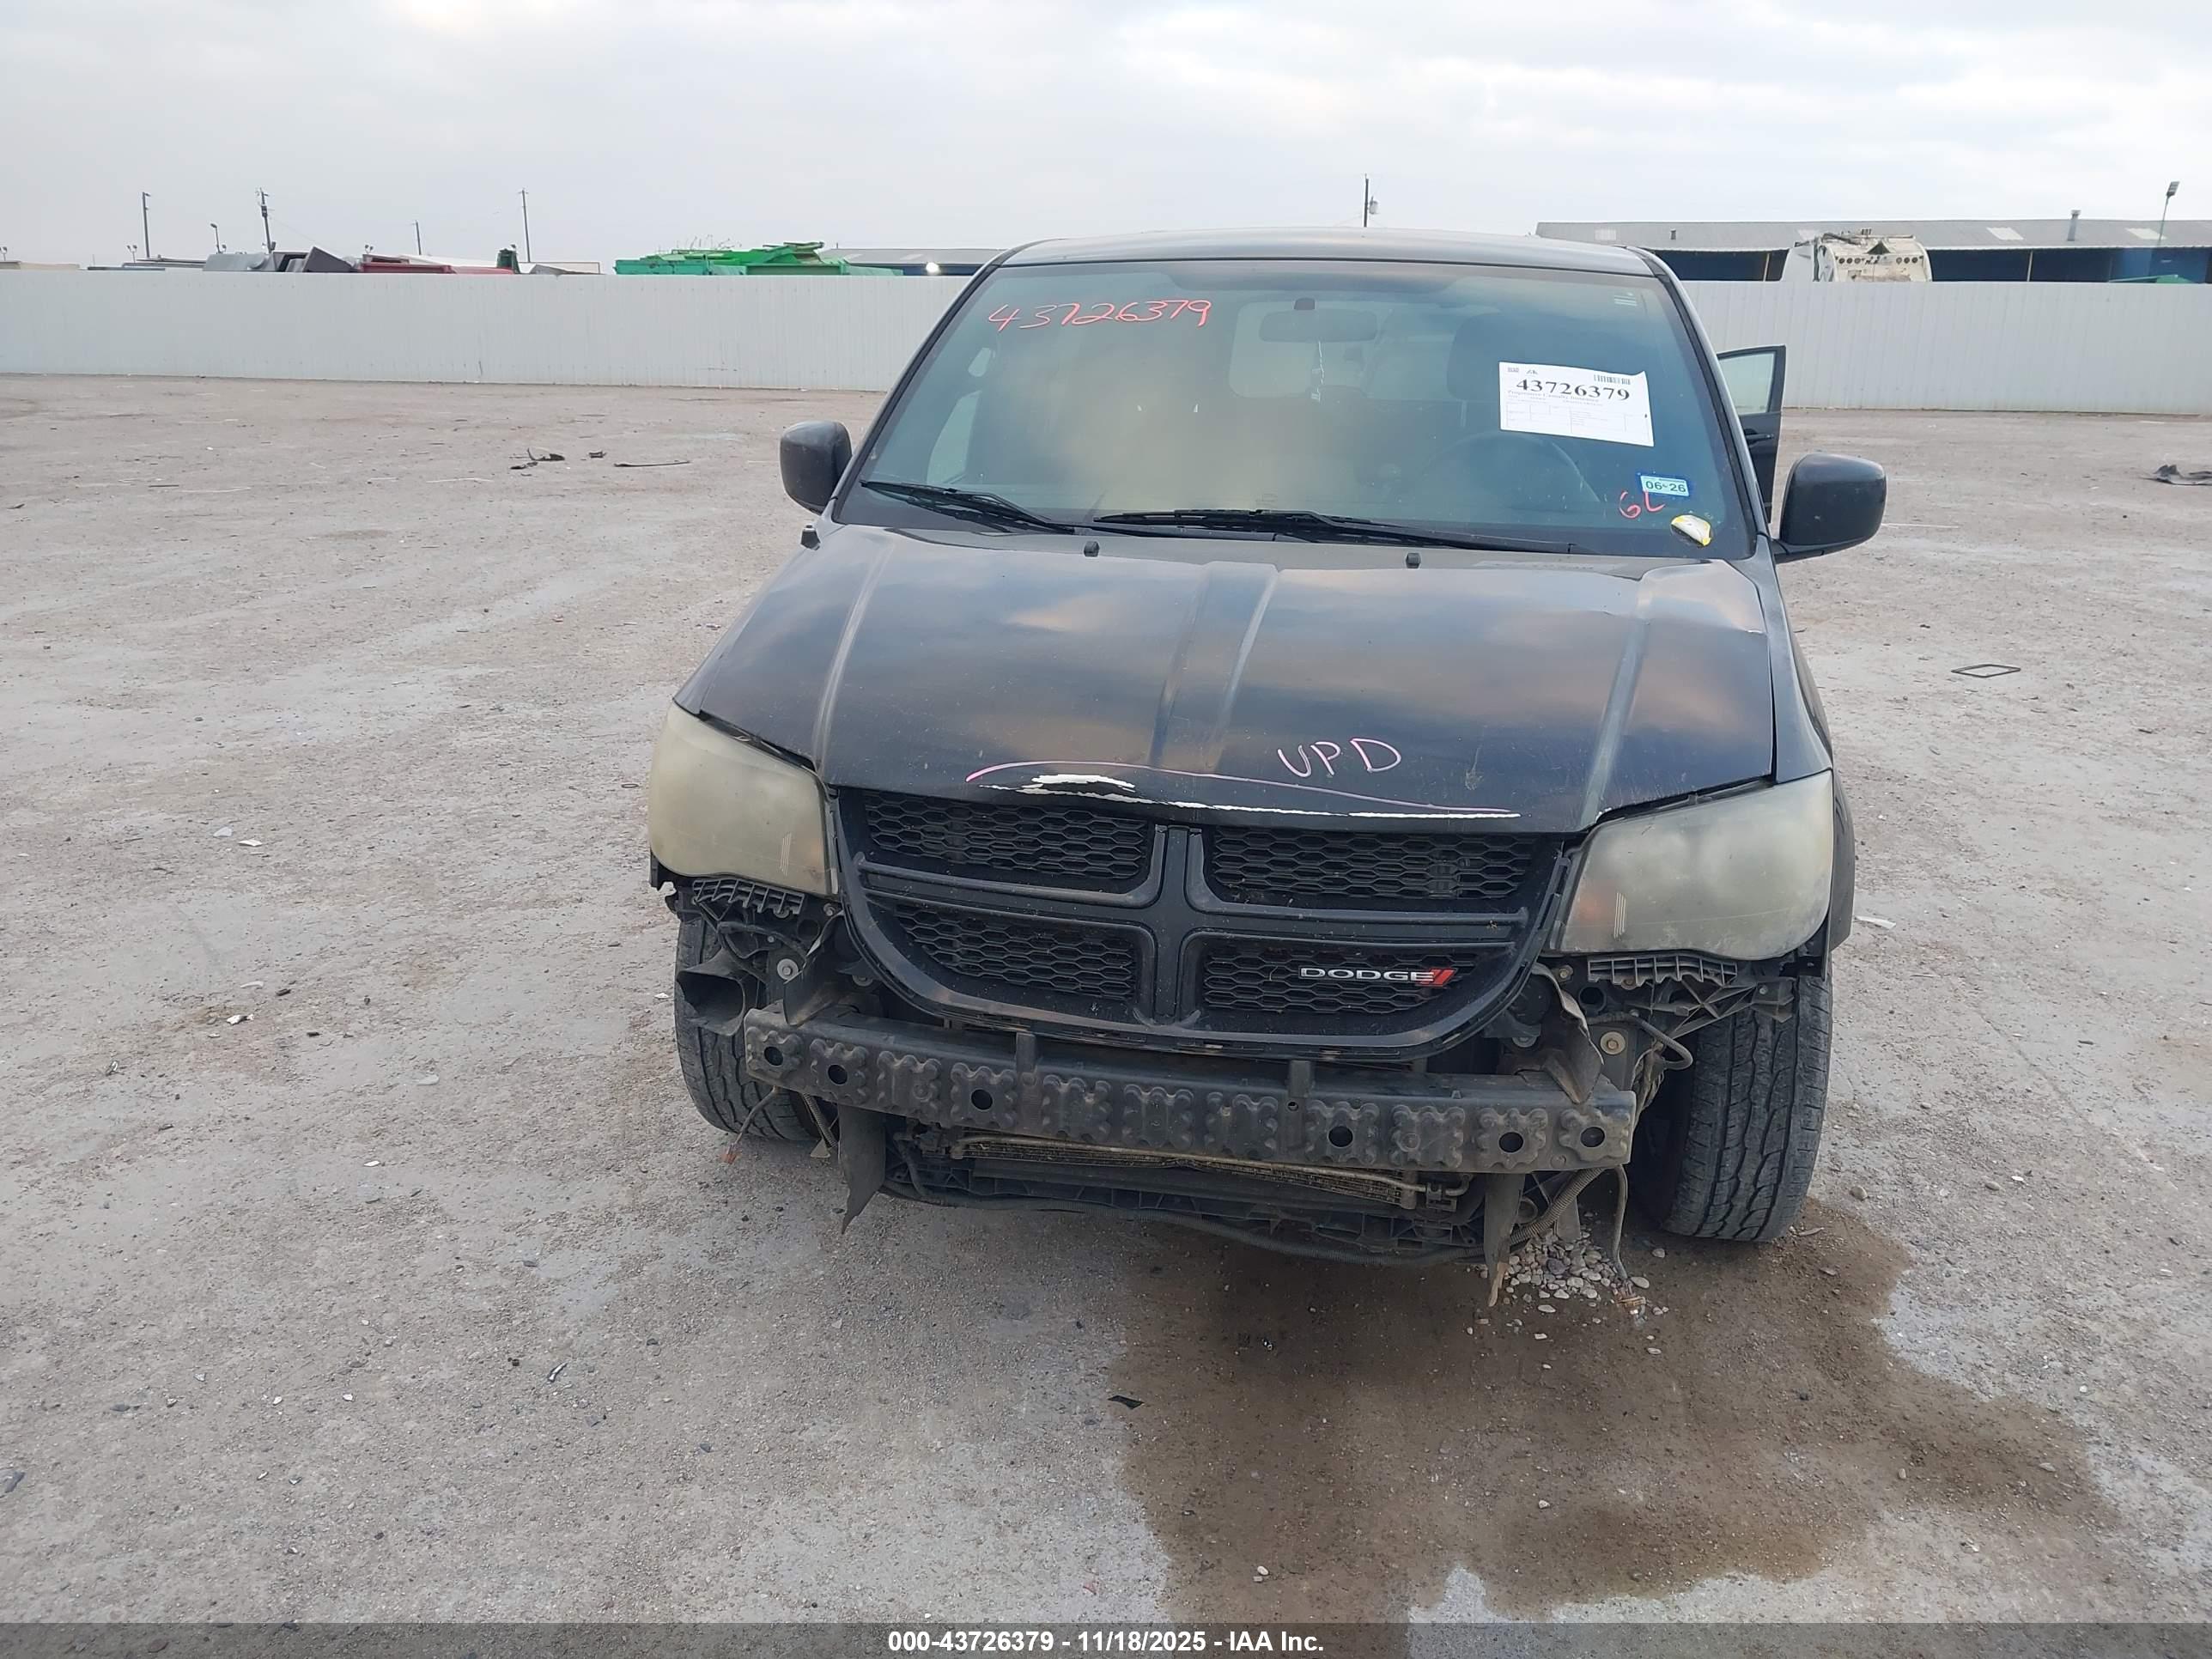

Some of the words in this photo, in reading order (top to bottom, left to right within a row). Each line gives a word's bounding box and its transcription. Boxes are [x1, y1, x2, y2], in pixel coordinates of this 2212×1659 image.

[988, 300, 1212, 332] 43726379
[1516, 379, 1630, 401] 43726379
[1300, 968, 1435, 982] DODGE
